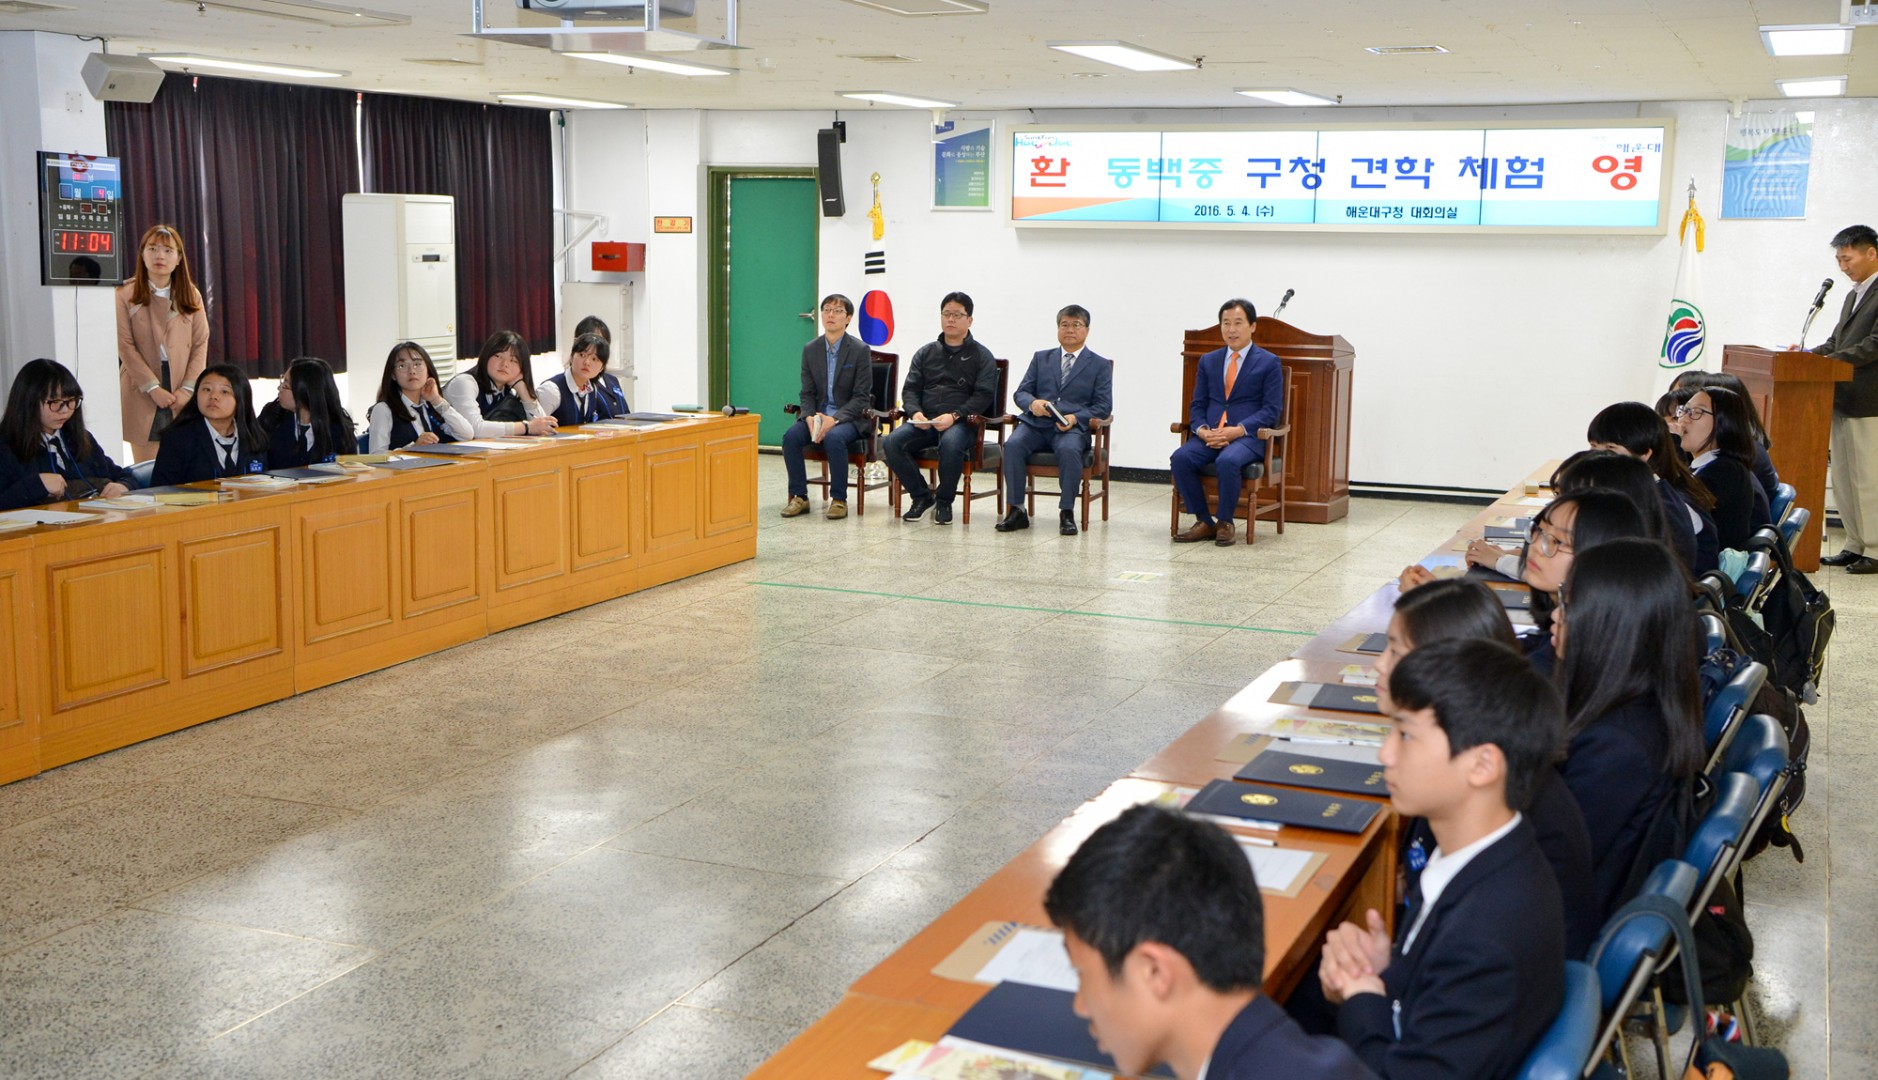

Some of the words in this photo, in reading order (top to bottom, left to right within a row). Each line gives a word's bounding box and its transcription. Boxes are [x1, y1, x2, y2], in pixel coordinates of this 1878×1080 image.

[1030, 155, 1071, 187] 환
[1107, 157, 1223, 189] 동백중
[1246, 156, 1326, 190] 구청
[1350, 156, 1435, 190] 견학
[1458, 156, 1545, 190] 체험
[1591, 155, 1643, 191] 영
[1194, 205, 1221, 217] 2016.
[1227, 205, 1235, 217] 5.
[1242, 205, 1250, 217] 4.
[1256, 205, 1275, 218] (수)
[1346, 206, 1403, 219] 해운대구청
[1411, 206, 1458, 219] 대회의실
[61, 232, 111, 252] 11:04
